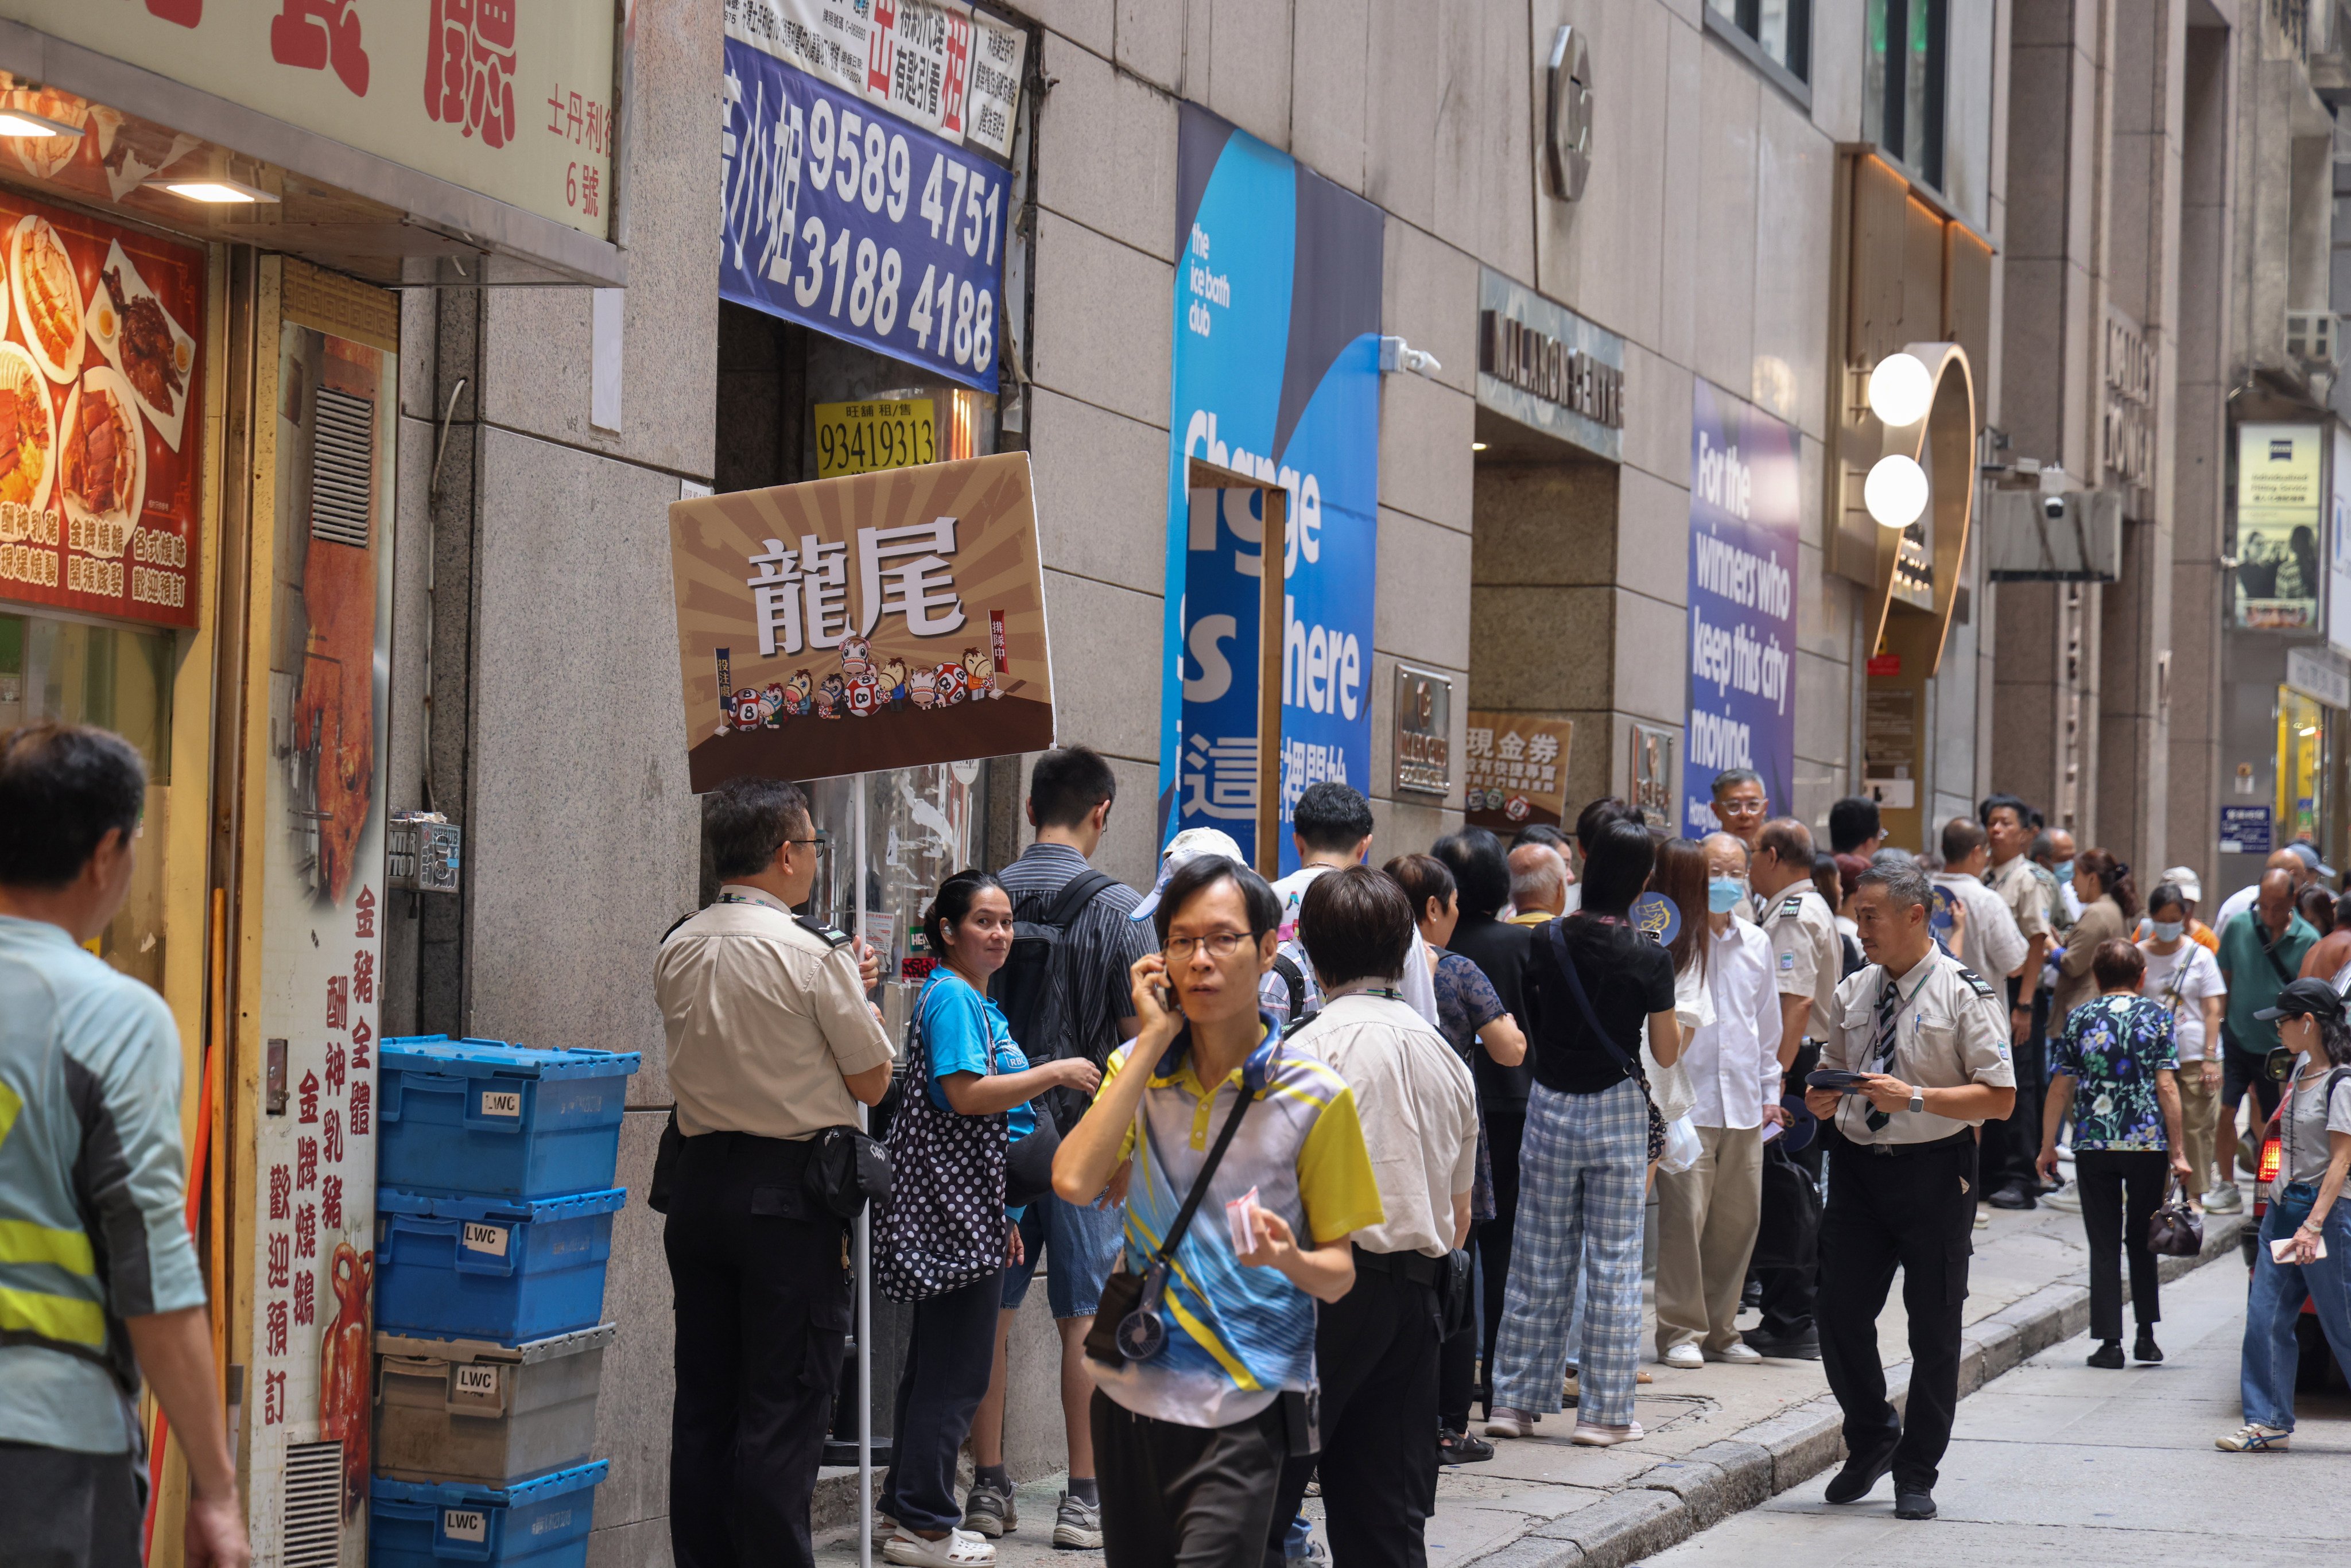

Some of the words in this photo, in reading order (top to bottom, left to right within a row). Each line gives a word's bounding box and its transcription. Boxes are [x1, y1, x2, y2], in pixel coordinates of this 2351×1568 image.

[895, 45, 940, 117] 有匙引看
[809, 98, 910, 223] 9589
[920, 152, 999, 266] 4751
[1191, 223, 1209, 260] the
[794, 216, 901, 336] 3188
[907, 263, 992, 372] 4188
[1190, 258, 1205, 298] ice
[1205, 265, 1230, 308] bath
[1189, 304, 1211, 337] club
[820, 419, 933, 471] 93419313
[1697, 430, 1722, 509] For
[1724, 445, 1750, 520] the
[133, 526, 187, 569] 各式燒味
[1696, 525, 1756, 606] winners
[1757, 550, 1790, 621] who
[747, 517, 965, 655] 龍尾
[992, 621, 1005, 661] 排隊中
[1283, 594, 1360, 721] here
[1692, 606, 1732, 697] keep
[1733, 623, 1761, 696] this
[1762, 633, 1790, 716] city
[717, 658, 731, 697] 投注處
[744, 705, 755, 720] 8
[348, 884, 375, 1136] 金豬全體
[321, 975, 348, 1230] 酬神乳豬
[484, 1093, 515, 1111] LWC
[293, 1068, 319, 1326] 金牌燒鵝
[465, 1224, 496, 1245] LWC
[265, 1163, 290, 1426] 歡迎預訂
[460, 1370, 492, 1389] LWC
[447, 1513, 478, 1531] LWC
